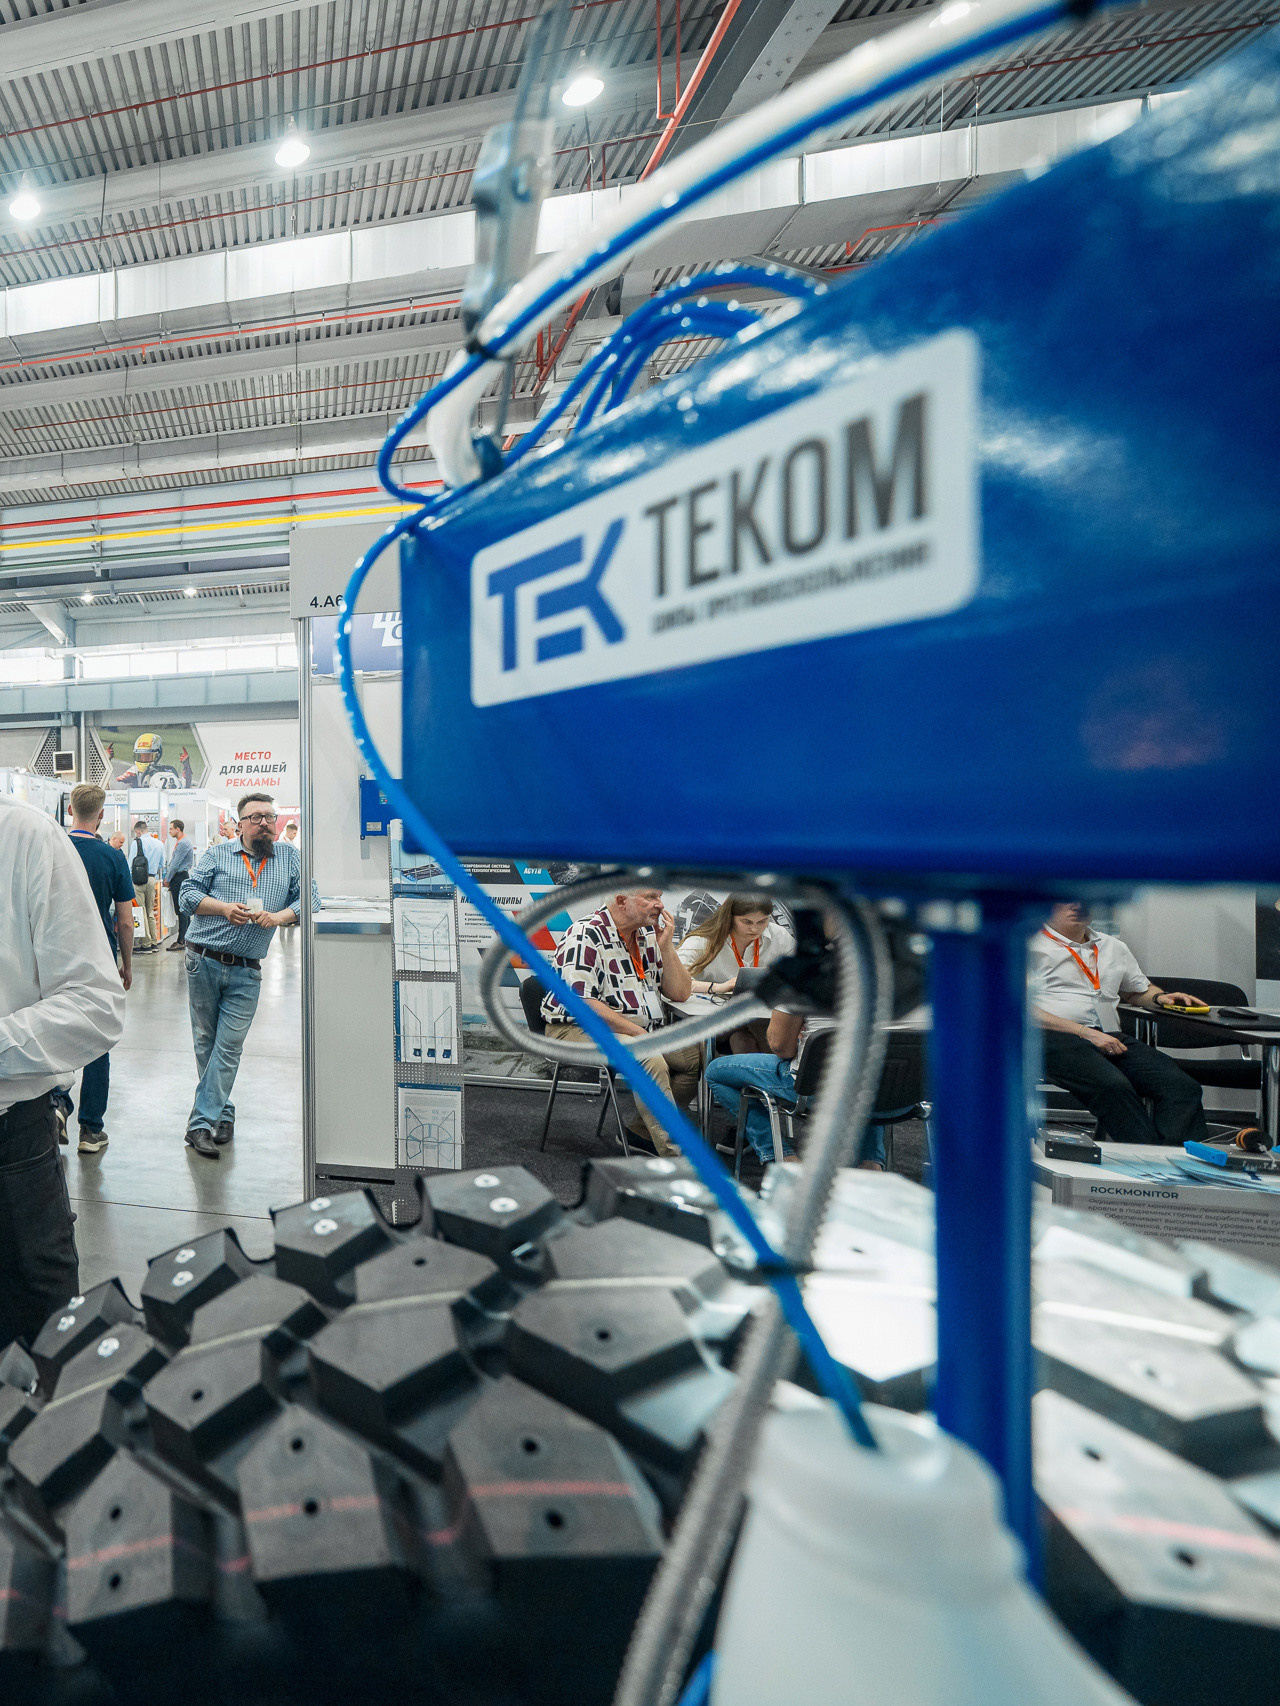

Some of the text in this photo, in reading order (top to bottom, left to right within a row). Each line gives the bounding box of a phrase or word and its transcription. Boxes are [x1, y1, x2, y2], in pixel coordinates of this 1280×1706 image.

[235, 751, 271, 760] МЕСТО
[219, 762, 287, 775] ДЛЯ ВАШЕЙ
[226, 778, 280, 787] РЕКЛАМЫ
[488, 896, 522, 905] РИНЦИПЫ
[1090, 1186, 1179, 1199] ROCKMONITOR
[1122, 1220, 1162, 1231] ботников,
